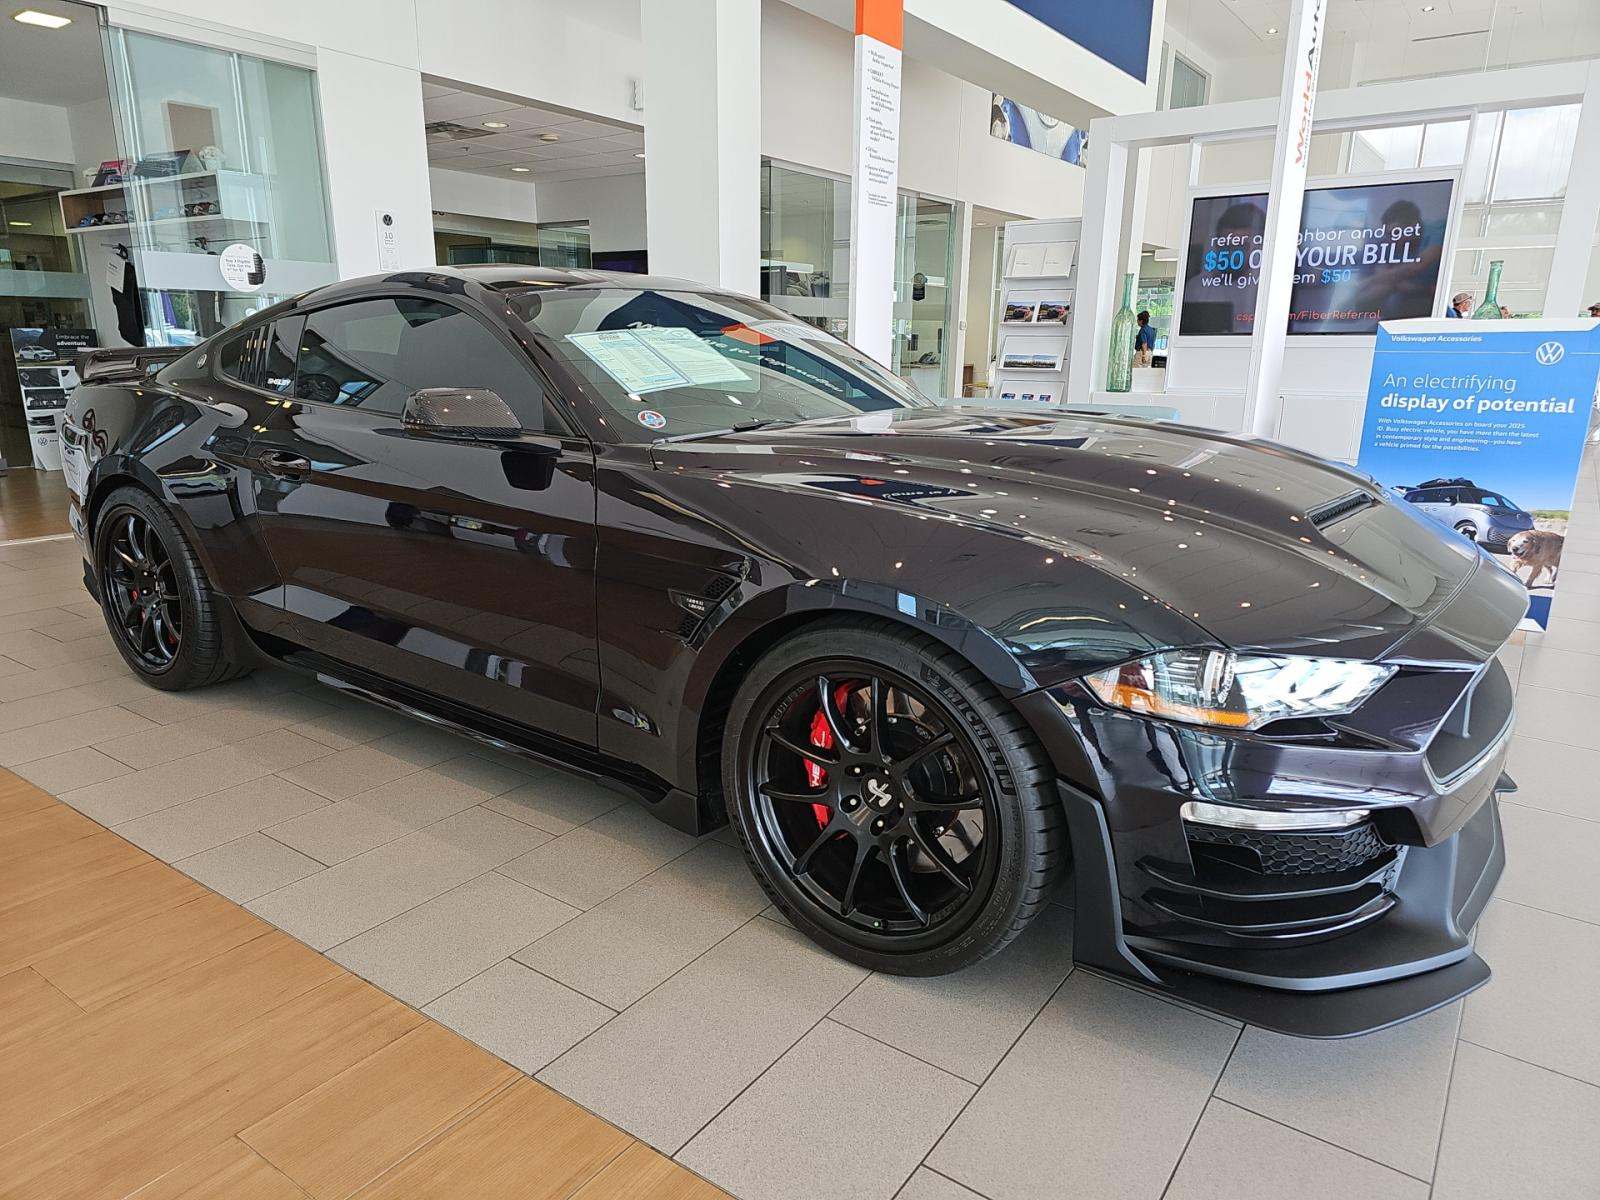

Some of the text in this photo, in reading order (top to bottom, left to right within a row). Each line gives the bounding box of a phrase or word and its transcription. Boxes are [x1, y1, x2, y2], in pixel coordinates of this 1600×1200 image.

[1210, 232, 1248, 247] refer
[1349, 224, 1386, 239] and
[1391, 222, 1422, 241] get
[1203, 249, 1245, 273] $50
[1296, 244, 1357, 268] YOUR
[1361, 241, 1422, 265] BILL.
[1201, 268, 1351, 289] we'll giv em $50
[1391, 334, 1483, 343] Volkswagen Accessories
[1383, 373, 1517, 394] An electrifying
[1380, 393, 1576, 414] display of potential
[942, 686, 1016, 790] MICHELIN
